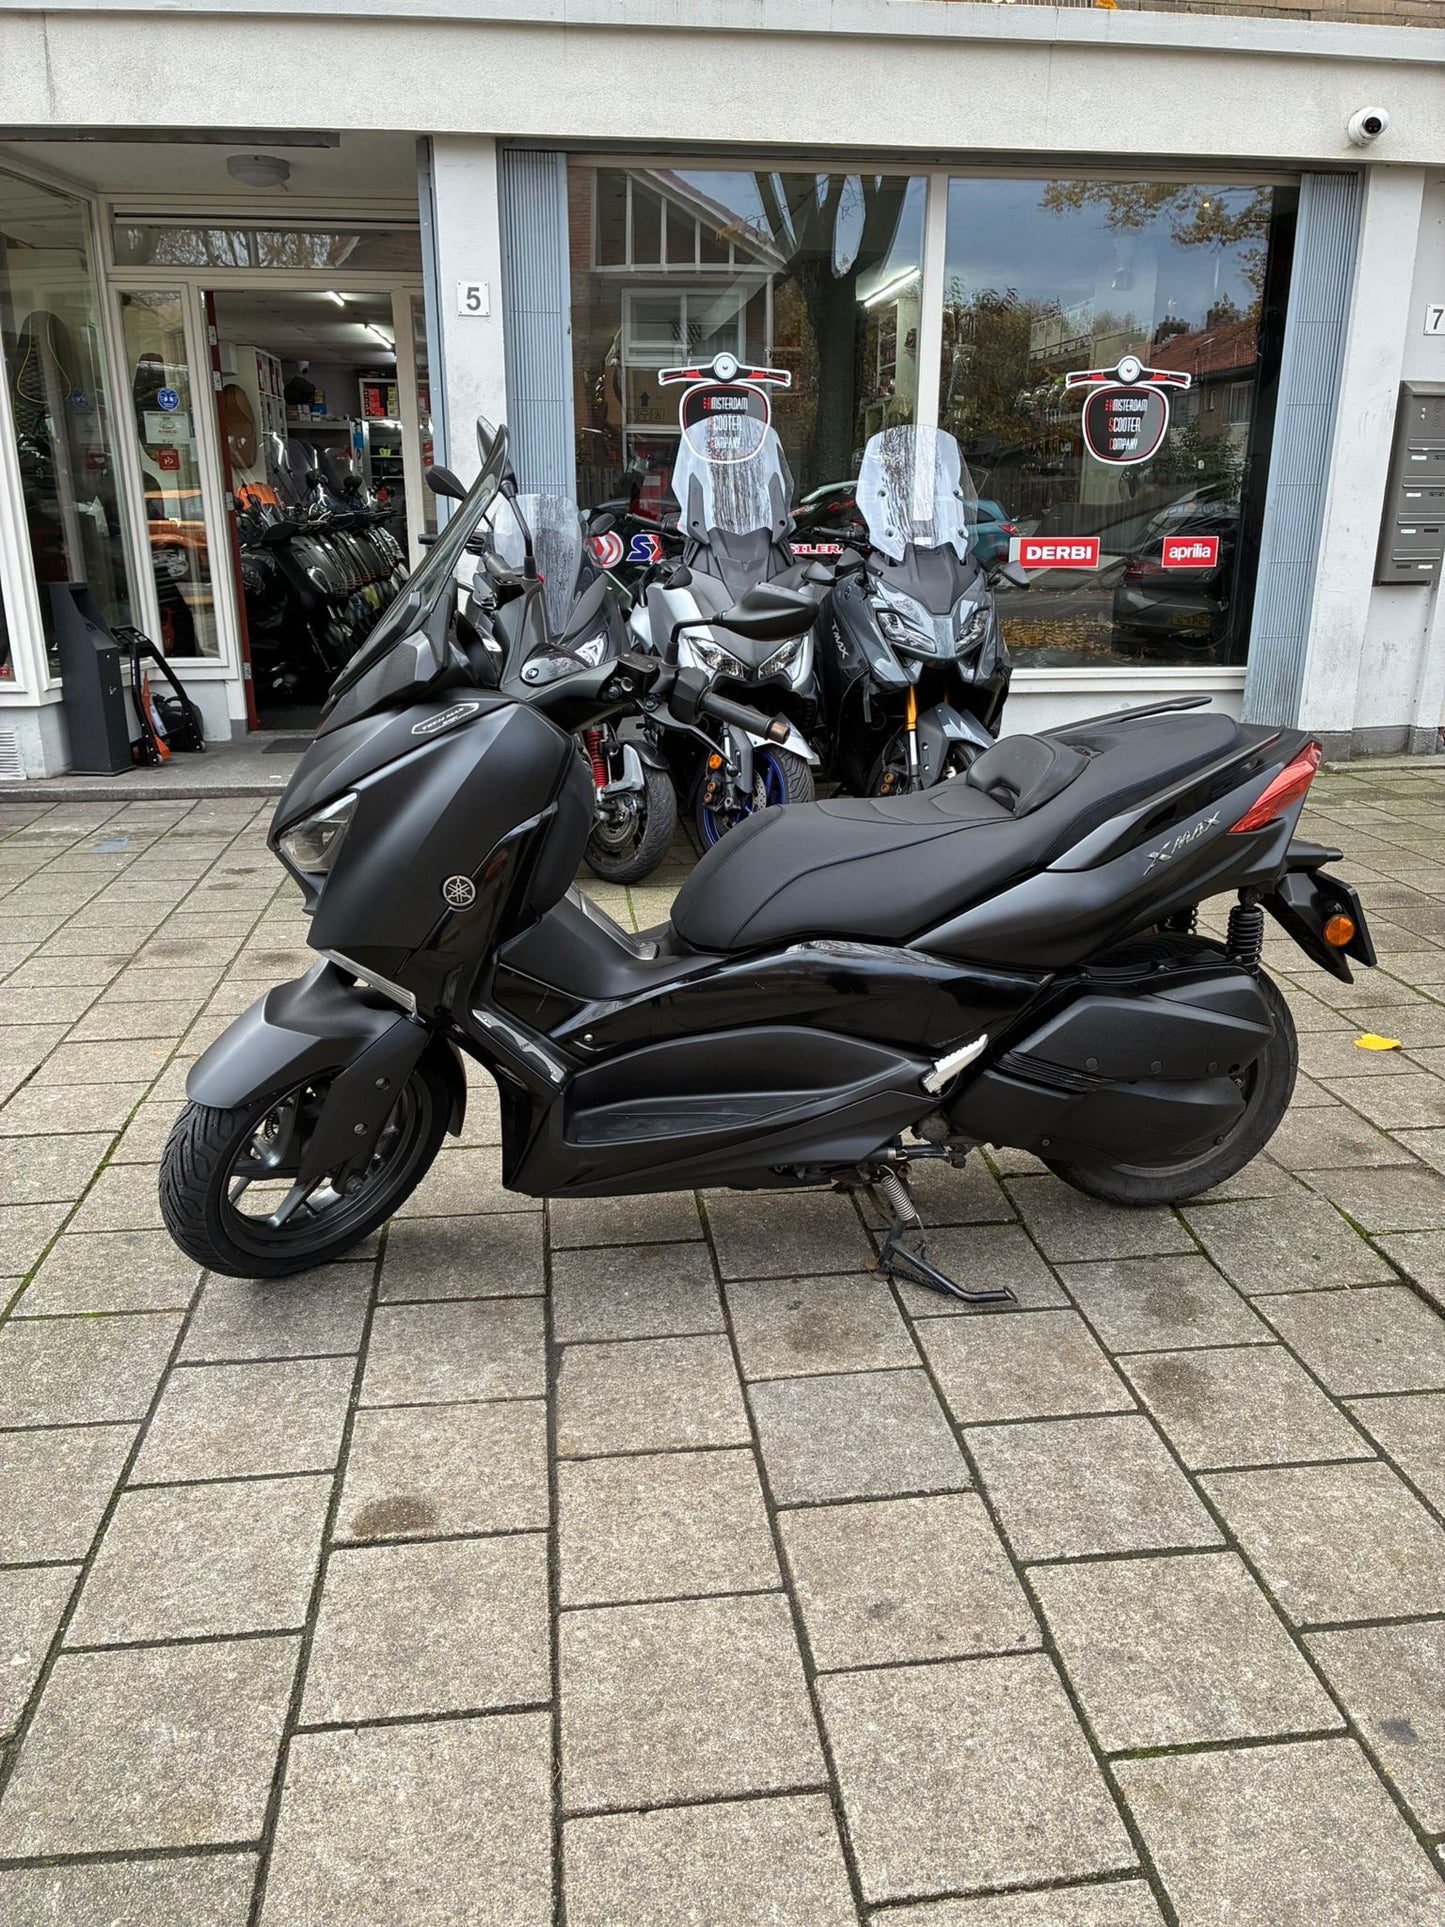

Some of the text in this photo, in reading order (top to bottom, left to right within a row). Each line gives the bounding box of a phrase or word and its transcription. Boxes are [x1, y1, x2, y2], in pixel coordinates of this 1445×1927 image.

[466, 287, 482, 311] 5
[1433, 308, 1444, 330] 7
[1108, 399, 1148, 412] AMSTERDAM
[1108, 417, 1141, 432] SCOOTER
[1109, 438, 1139, 450] COMPANY
[1026, 546, 1092, 560] DERBI
[1168, 543, 1212, 561] aprilia
[831, 617, 849, 659] TMAX
